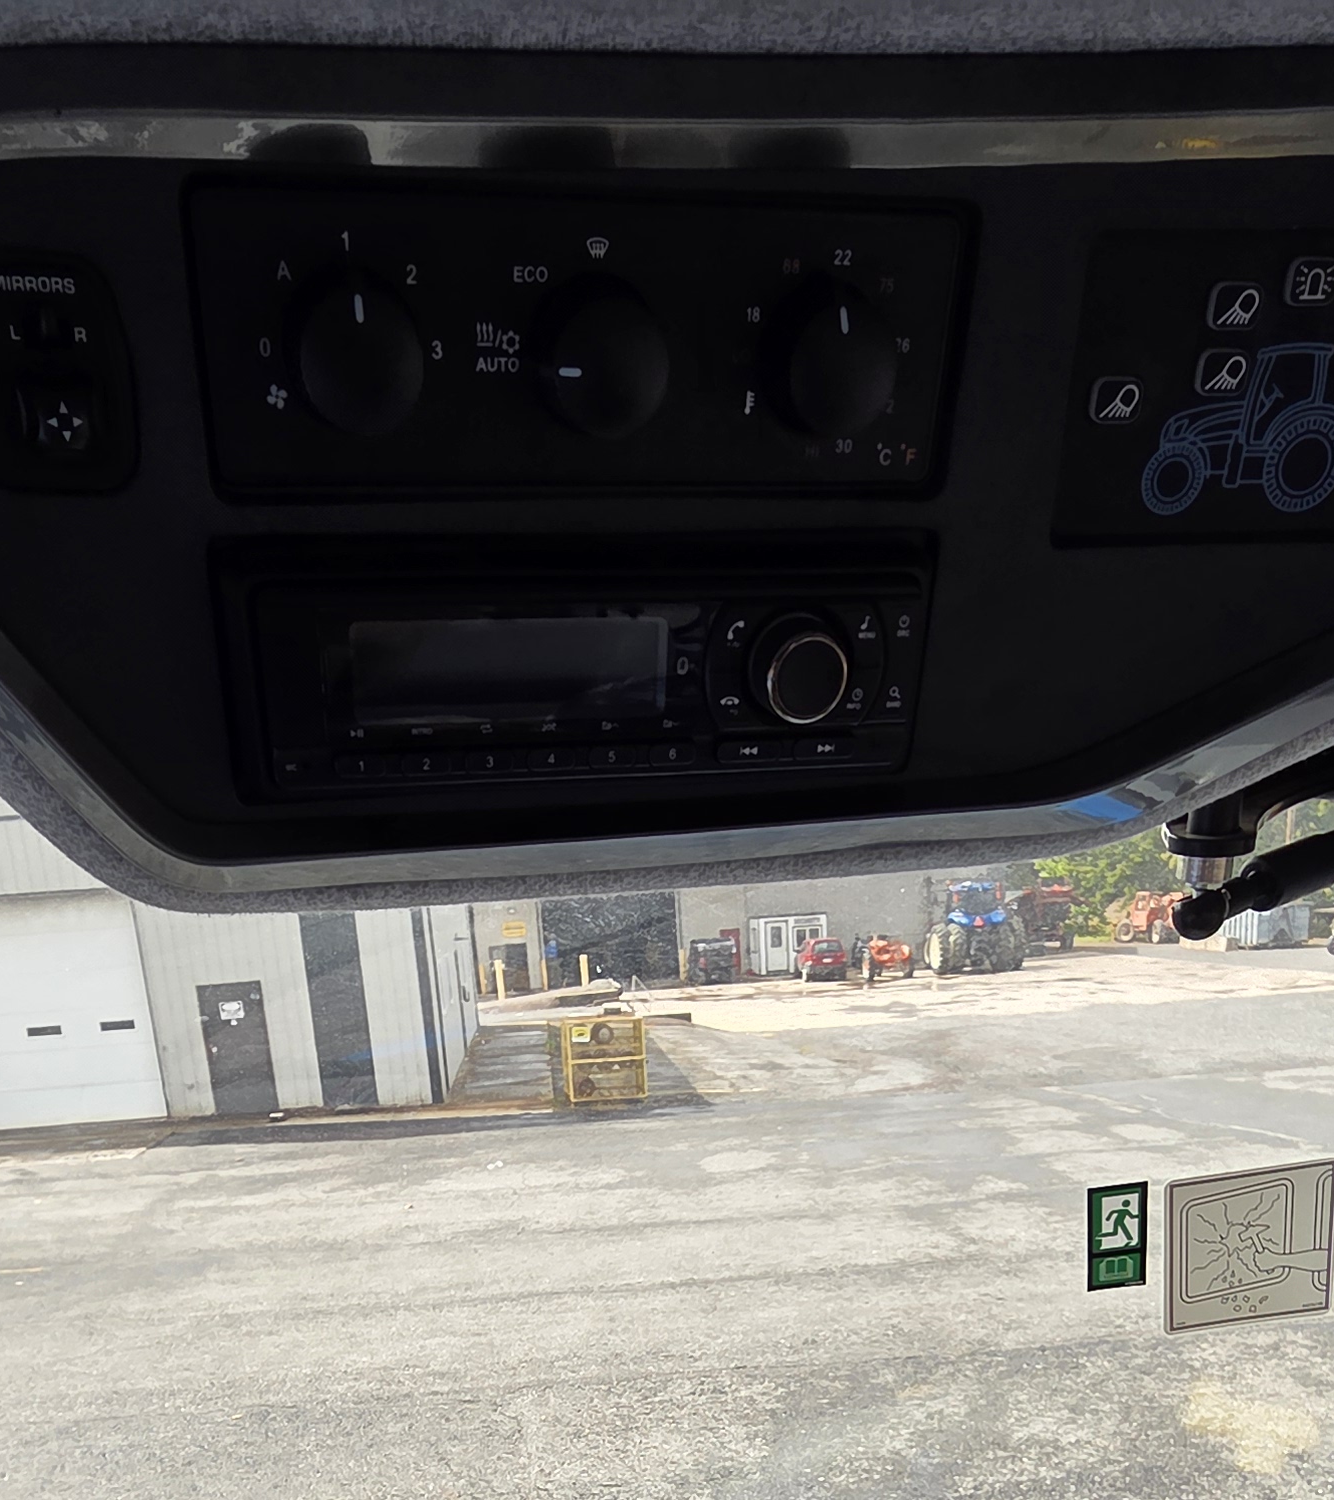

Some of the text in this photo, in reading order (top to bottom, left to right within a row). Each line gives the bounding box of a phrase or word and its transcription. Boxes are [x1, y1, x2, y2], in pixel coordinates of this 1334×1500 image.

[341, 230, 350, 251] 1
[834, 249, 852, 266] 22
[277, 260, 292, 281] A
[406, 264, 418, 285] 2
[513, 265, 549, 283] ECO
[746, 306, 762, 323] 18
[9, 324, 87, 342] L R
[259, 337, 271, 358] 0
[431, 340, 443, 360] 3
[475, 356, 520, 373] AUTO
[835, 438, 854, 453] 30
[358, 747, 677, 772] 1 2 3 4 5 6
